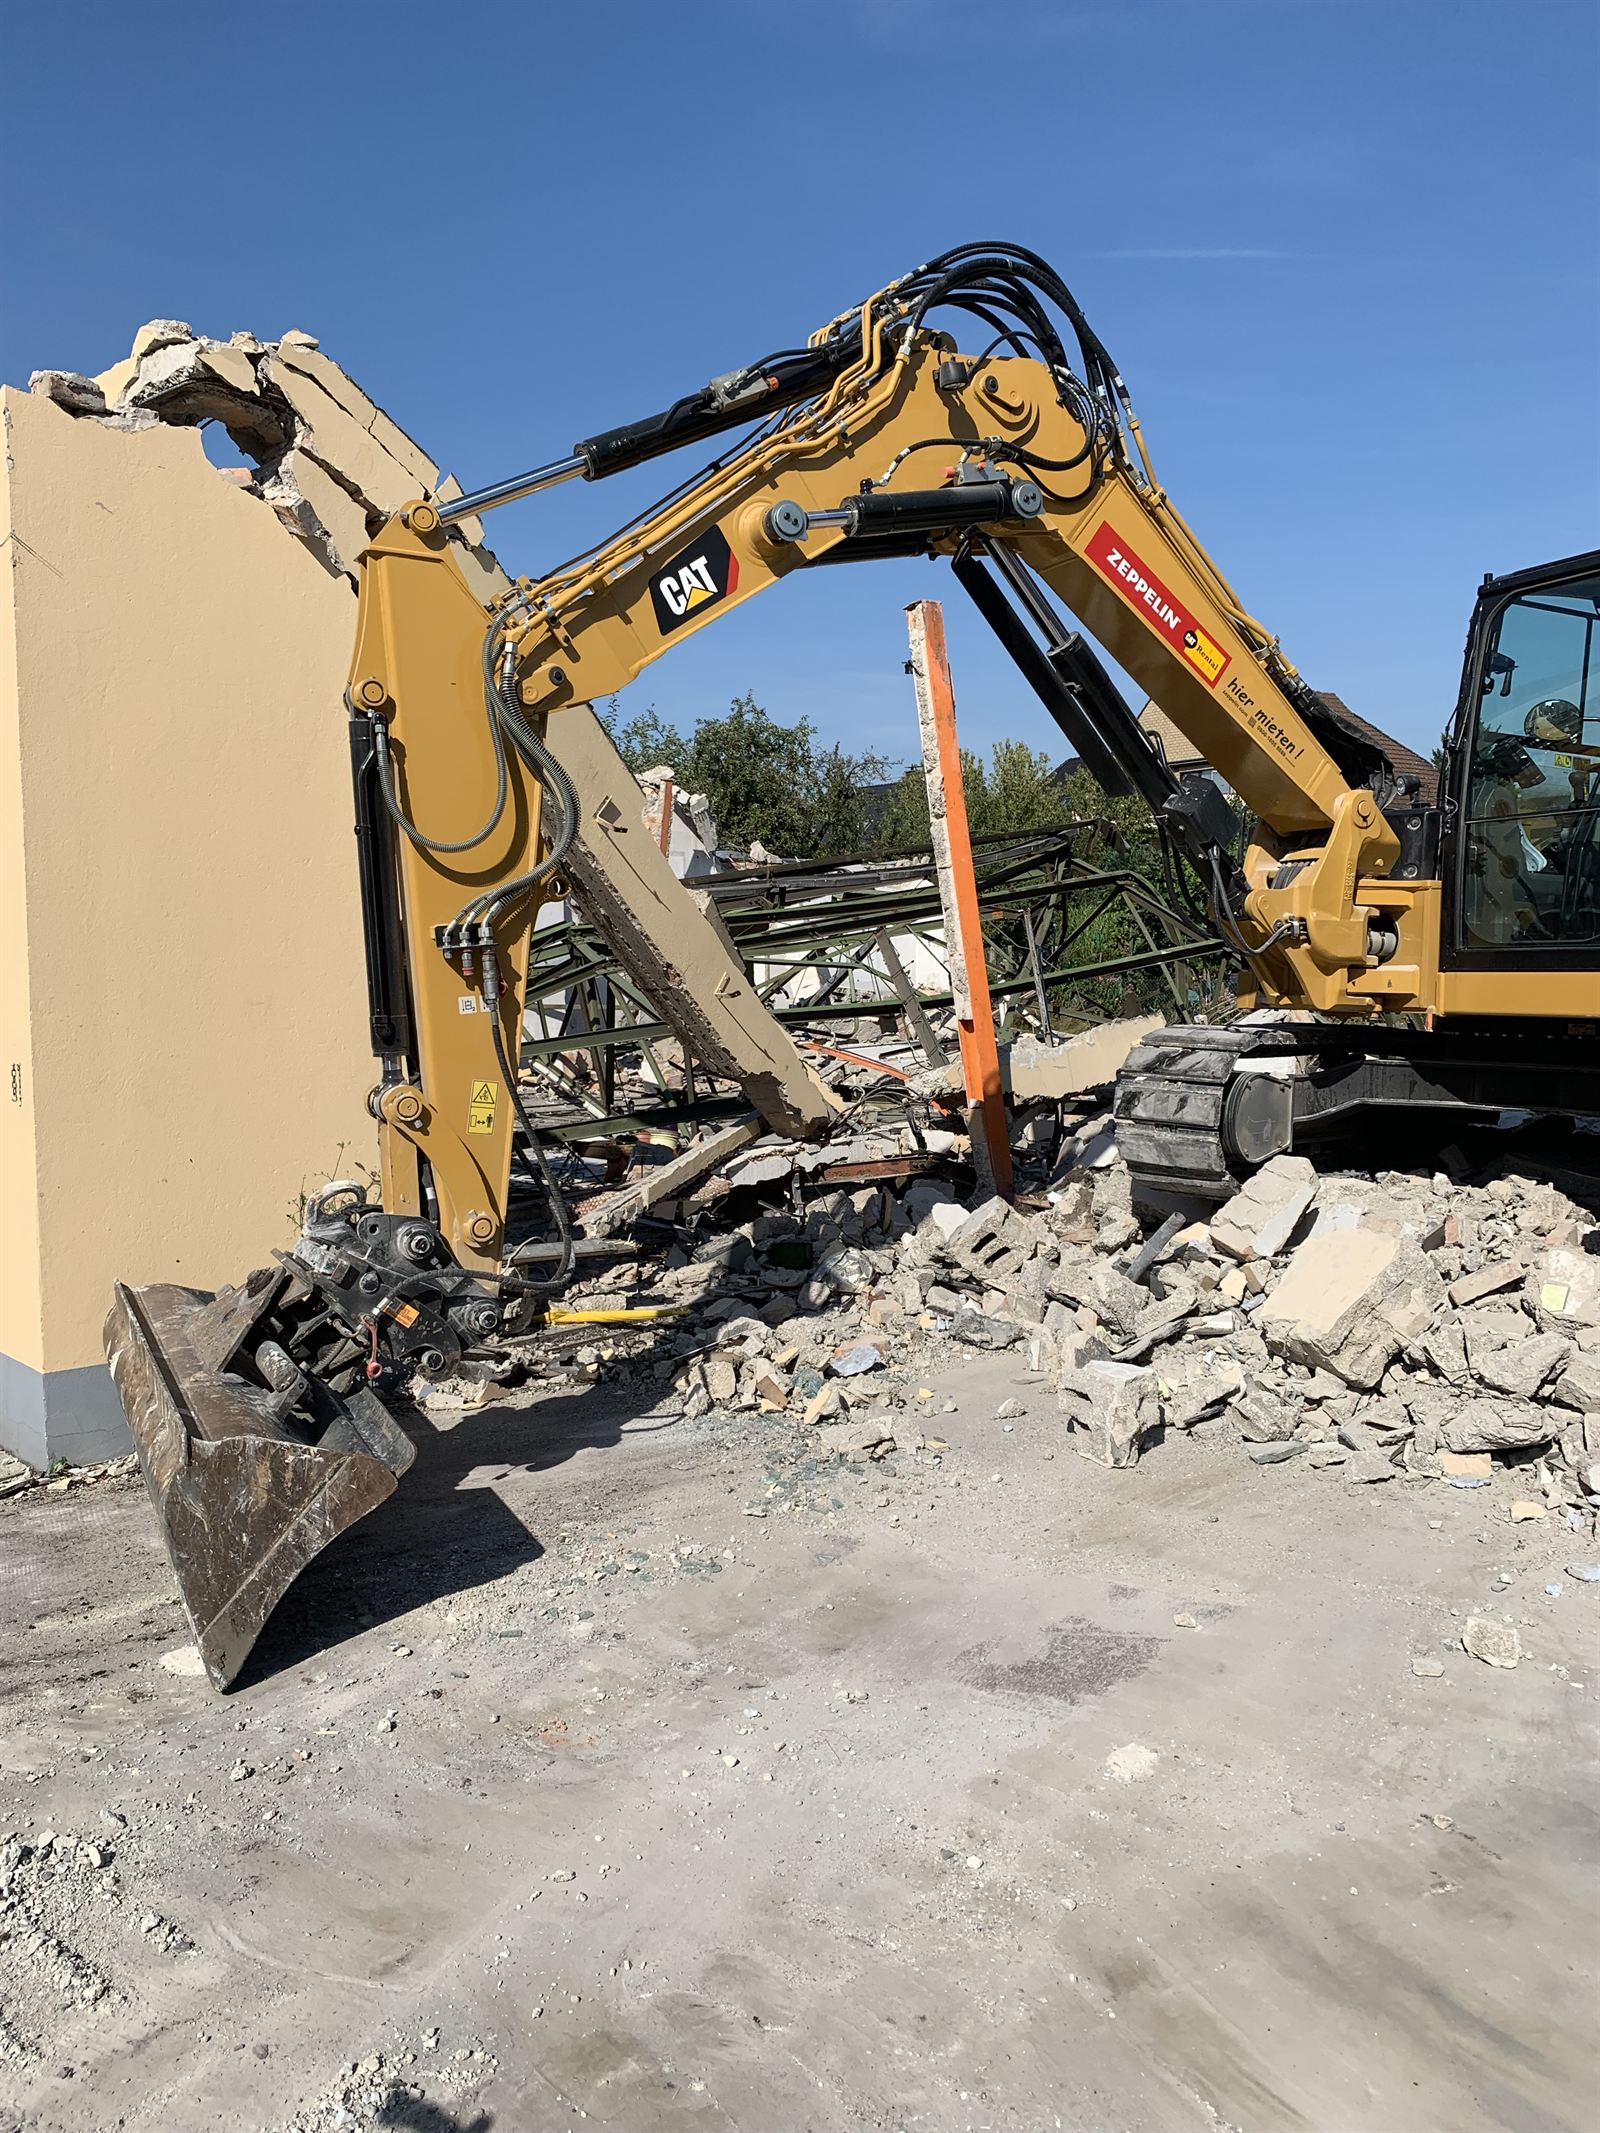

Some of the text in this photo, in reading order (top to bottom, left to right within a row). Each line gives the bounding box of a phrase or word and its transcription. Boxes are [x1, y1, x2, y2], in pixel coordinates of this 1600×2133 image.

[659, 555, 719, 616] CAT
[1106, 547, 1180, 630] ZEPPELIN
[1184, 632, 1219, 671] CAT Rental
[1227, 677, 1254, 706] hier
